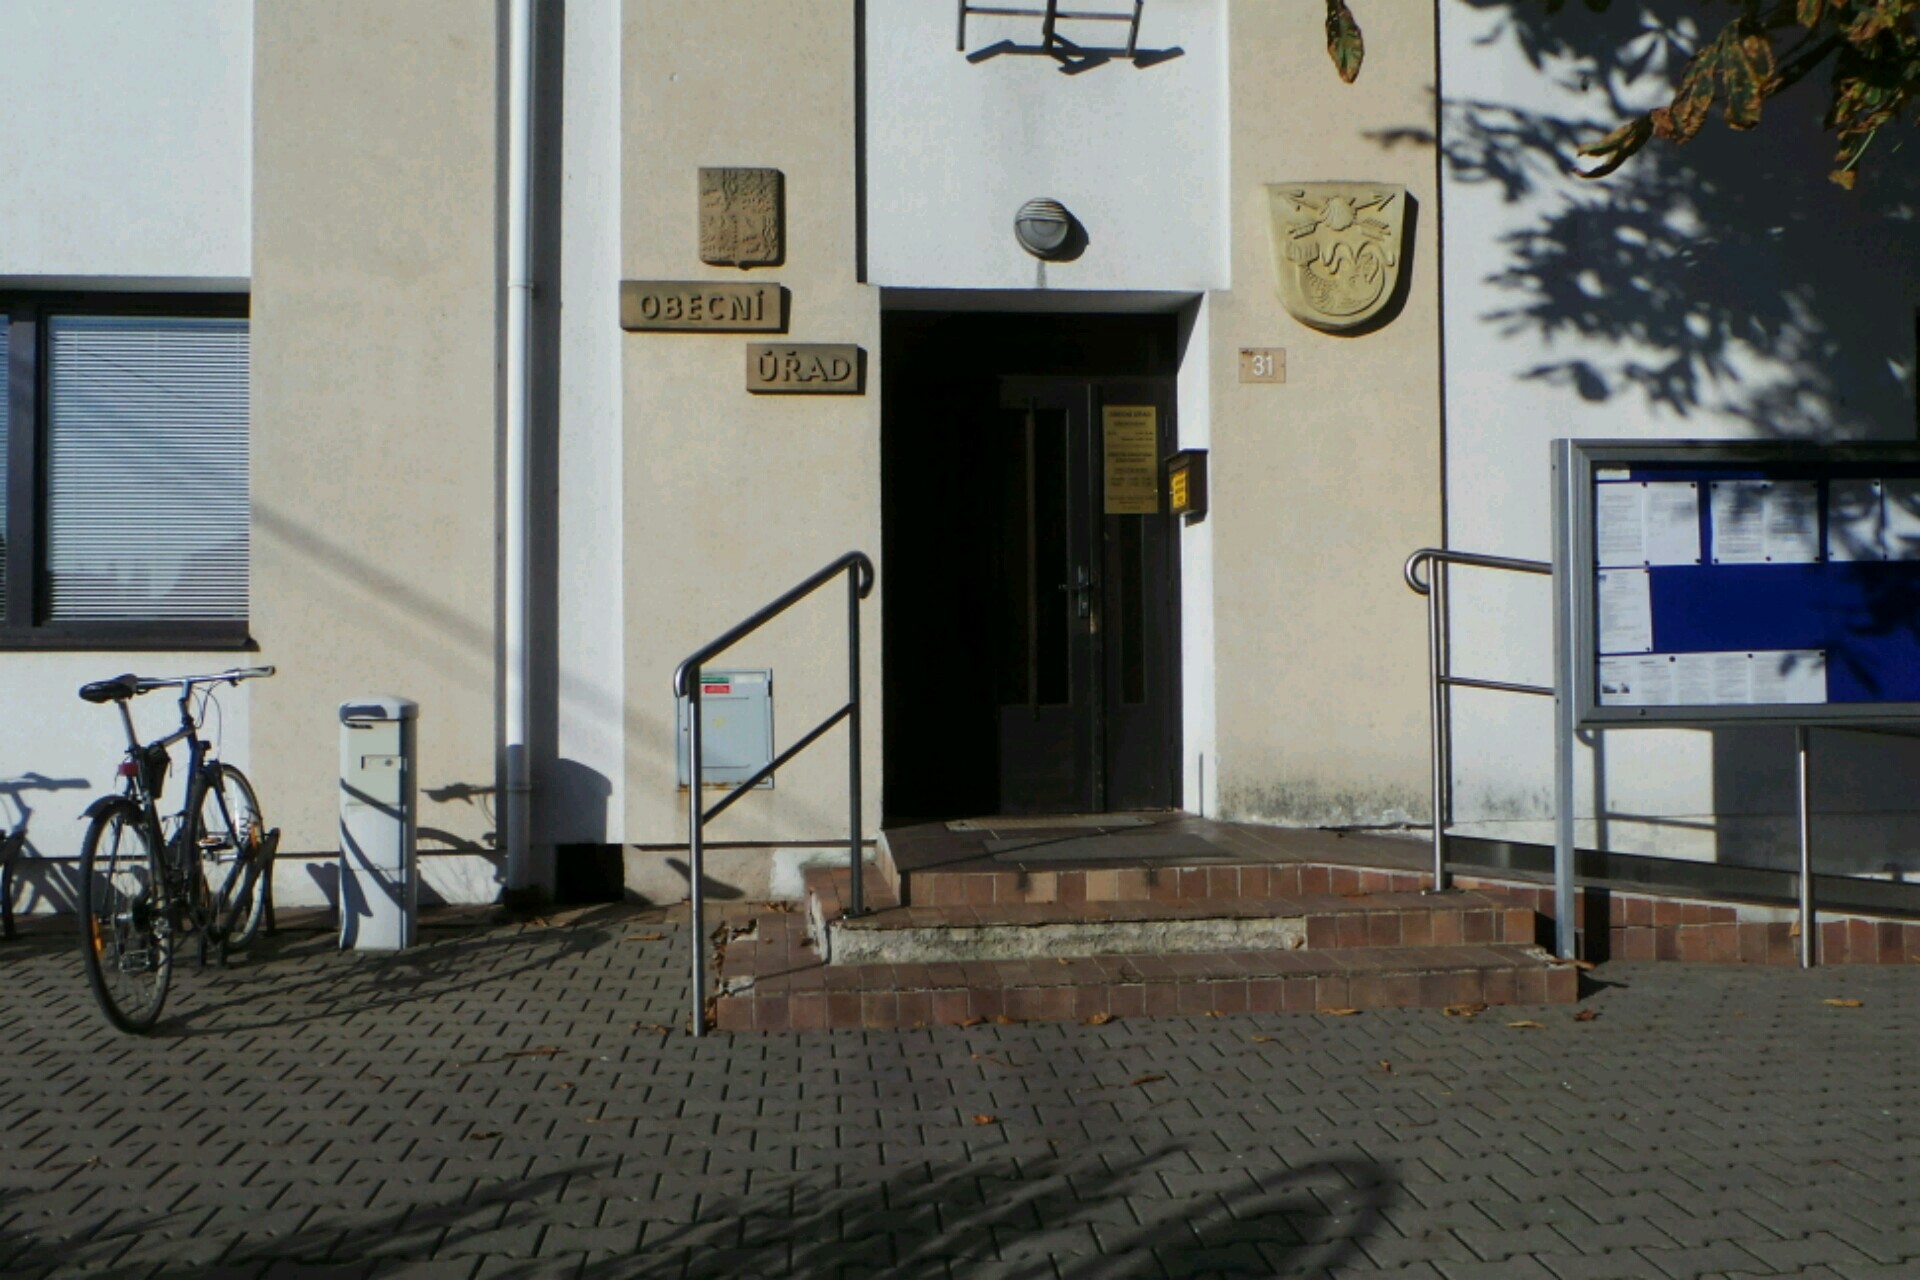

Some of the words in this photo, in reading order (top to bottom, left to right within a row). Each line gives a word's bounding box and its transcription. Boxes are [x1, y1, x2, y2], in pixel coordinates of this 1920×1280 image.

[640, 289, 764, 321] OBECNÍ
[759, 350, 852, 382] ÚŘAD
[1252, 354, 1273, 377] 31
